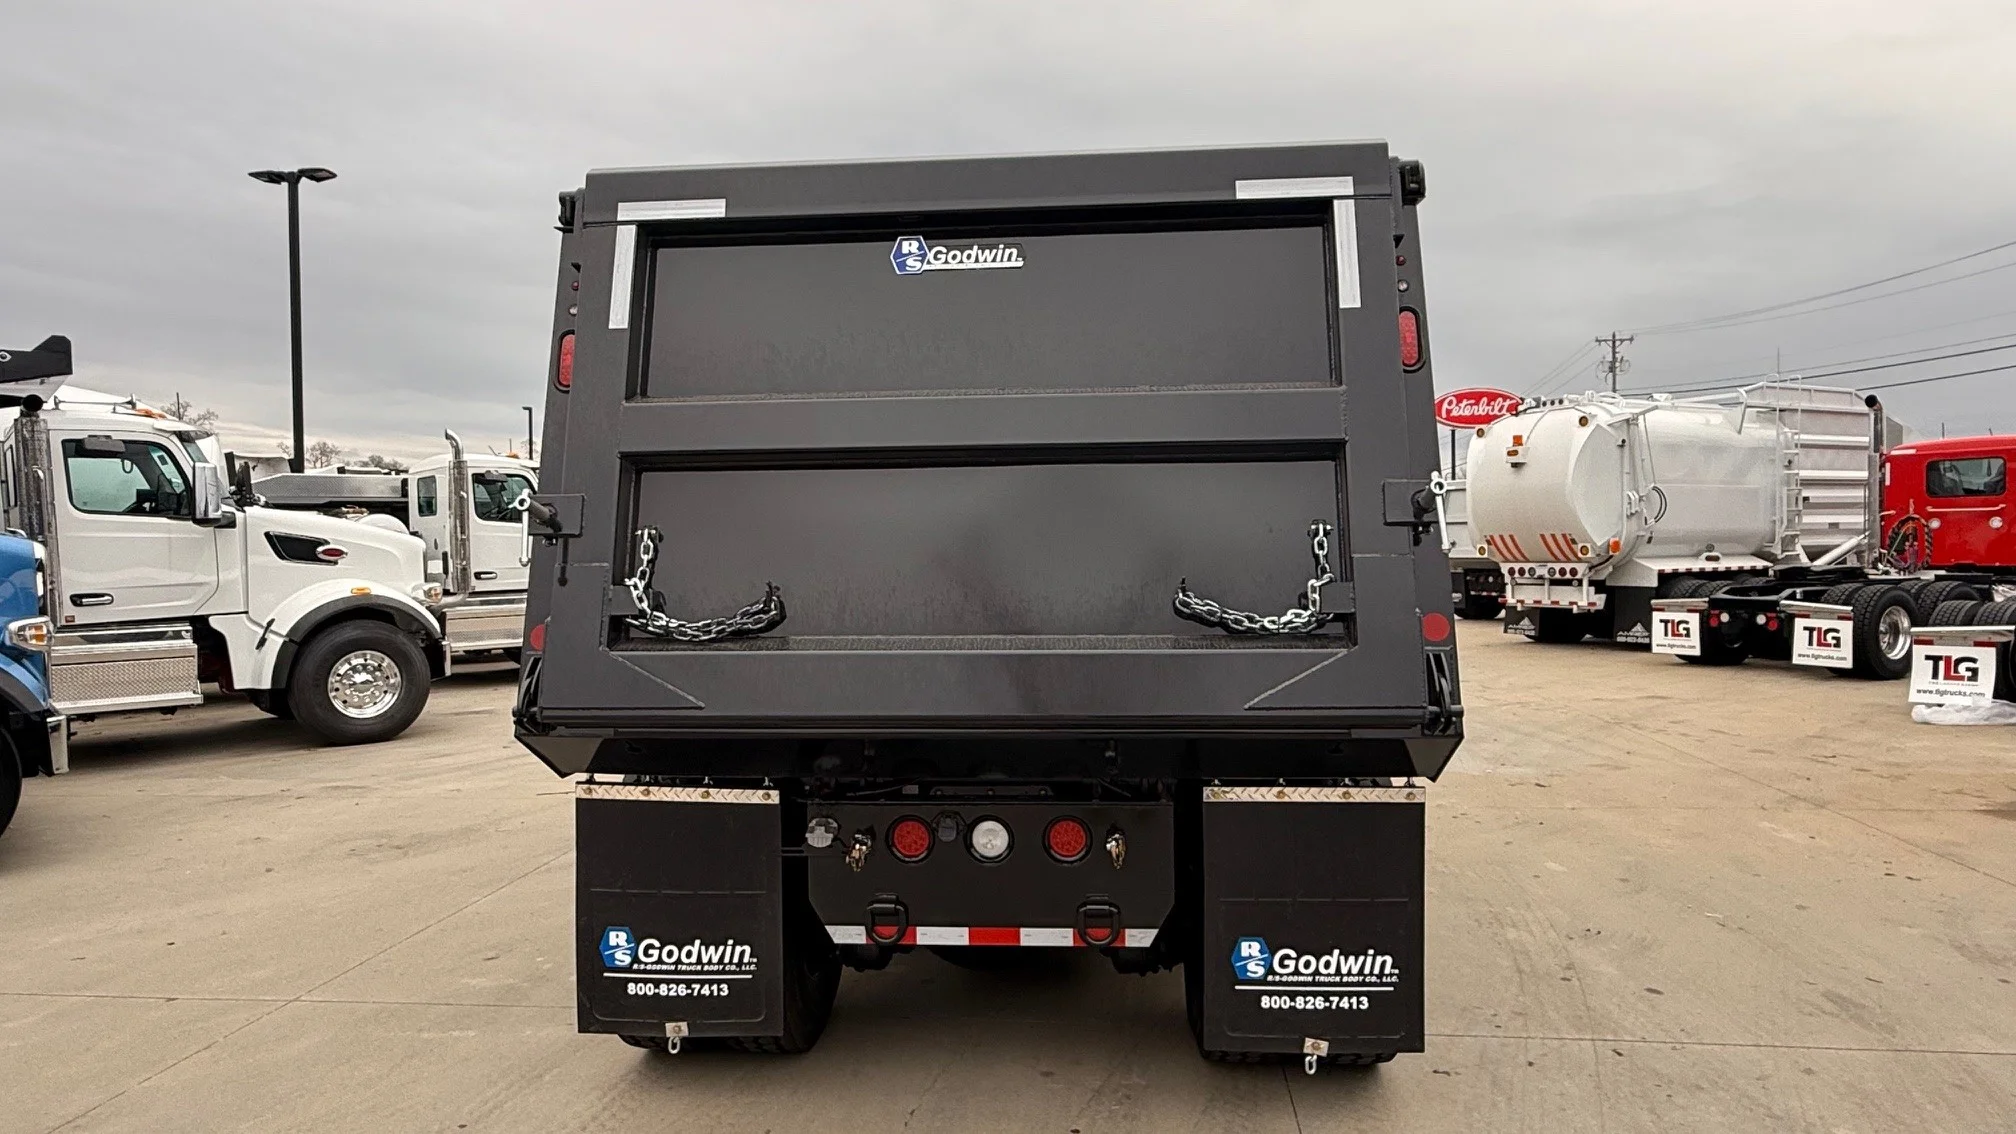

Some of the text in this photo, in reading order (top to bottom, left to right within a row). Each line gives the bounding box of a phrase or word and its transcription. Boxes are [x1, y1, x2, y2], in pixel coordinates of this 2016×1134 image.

[1441, 396, 1517, 418] Peterbilt
[1659, 619, 1691, 638] TLG
[1803, 626, 1841, 648] TLG
[1924, 654, 1979, 683] TLG
[1315, 975, 1341, 983] TRUCK
[1342, 975, 1363, 983] BODY
[626, 982, 729, 997] 800-826-7413
[1260, 995, 1370, 1010] 800-826-7413
